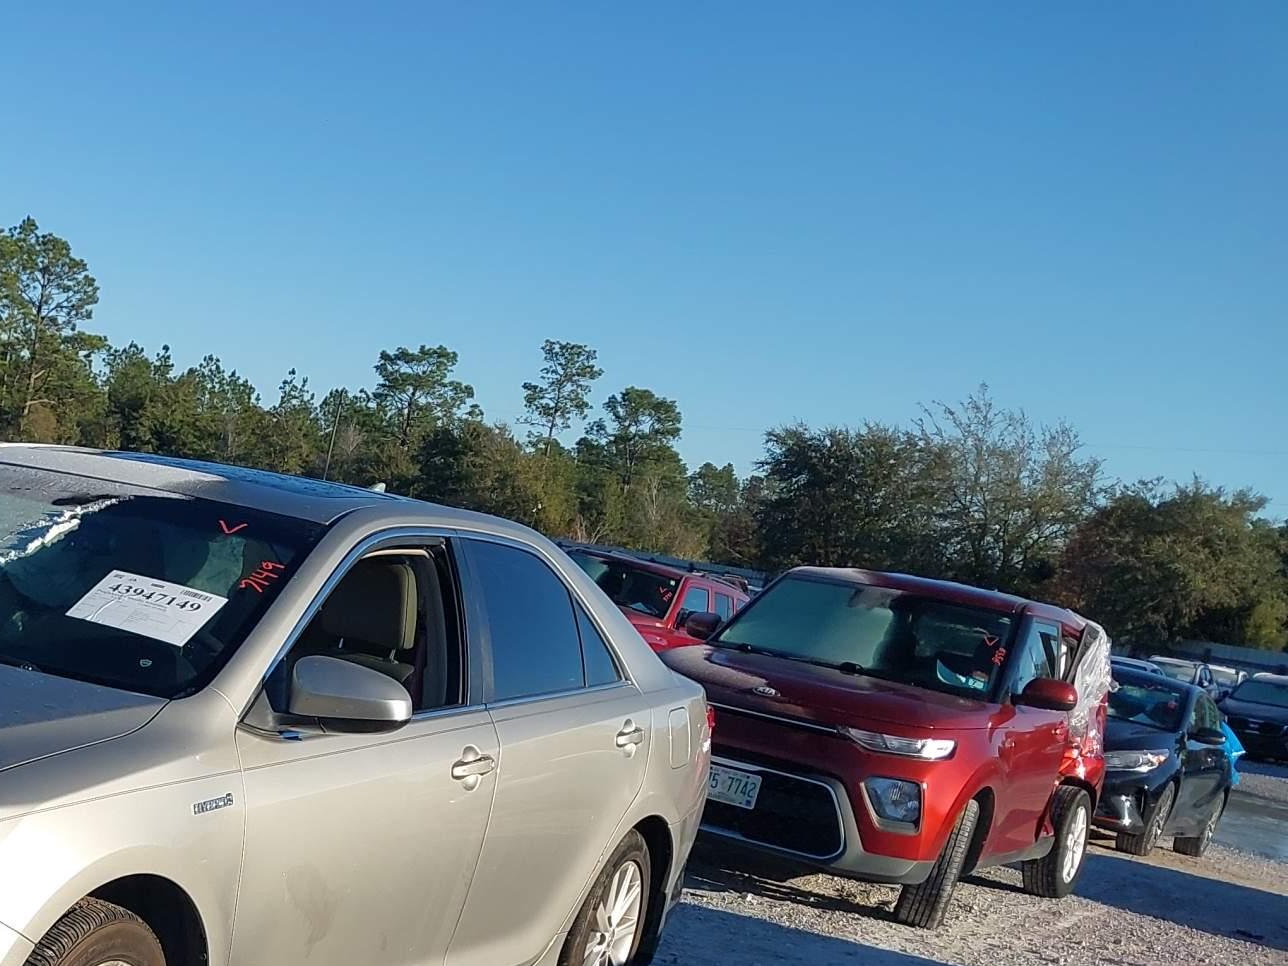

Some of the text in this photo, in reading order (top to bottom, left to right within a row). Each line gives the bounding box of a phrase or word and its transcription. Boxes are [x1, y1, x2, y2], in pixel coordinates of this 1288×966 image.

[239, 560, 286, 593] 7149
[108, 583, 202, 613] 43947149
[727, 776, 757, 799] 7742
